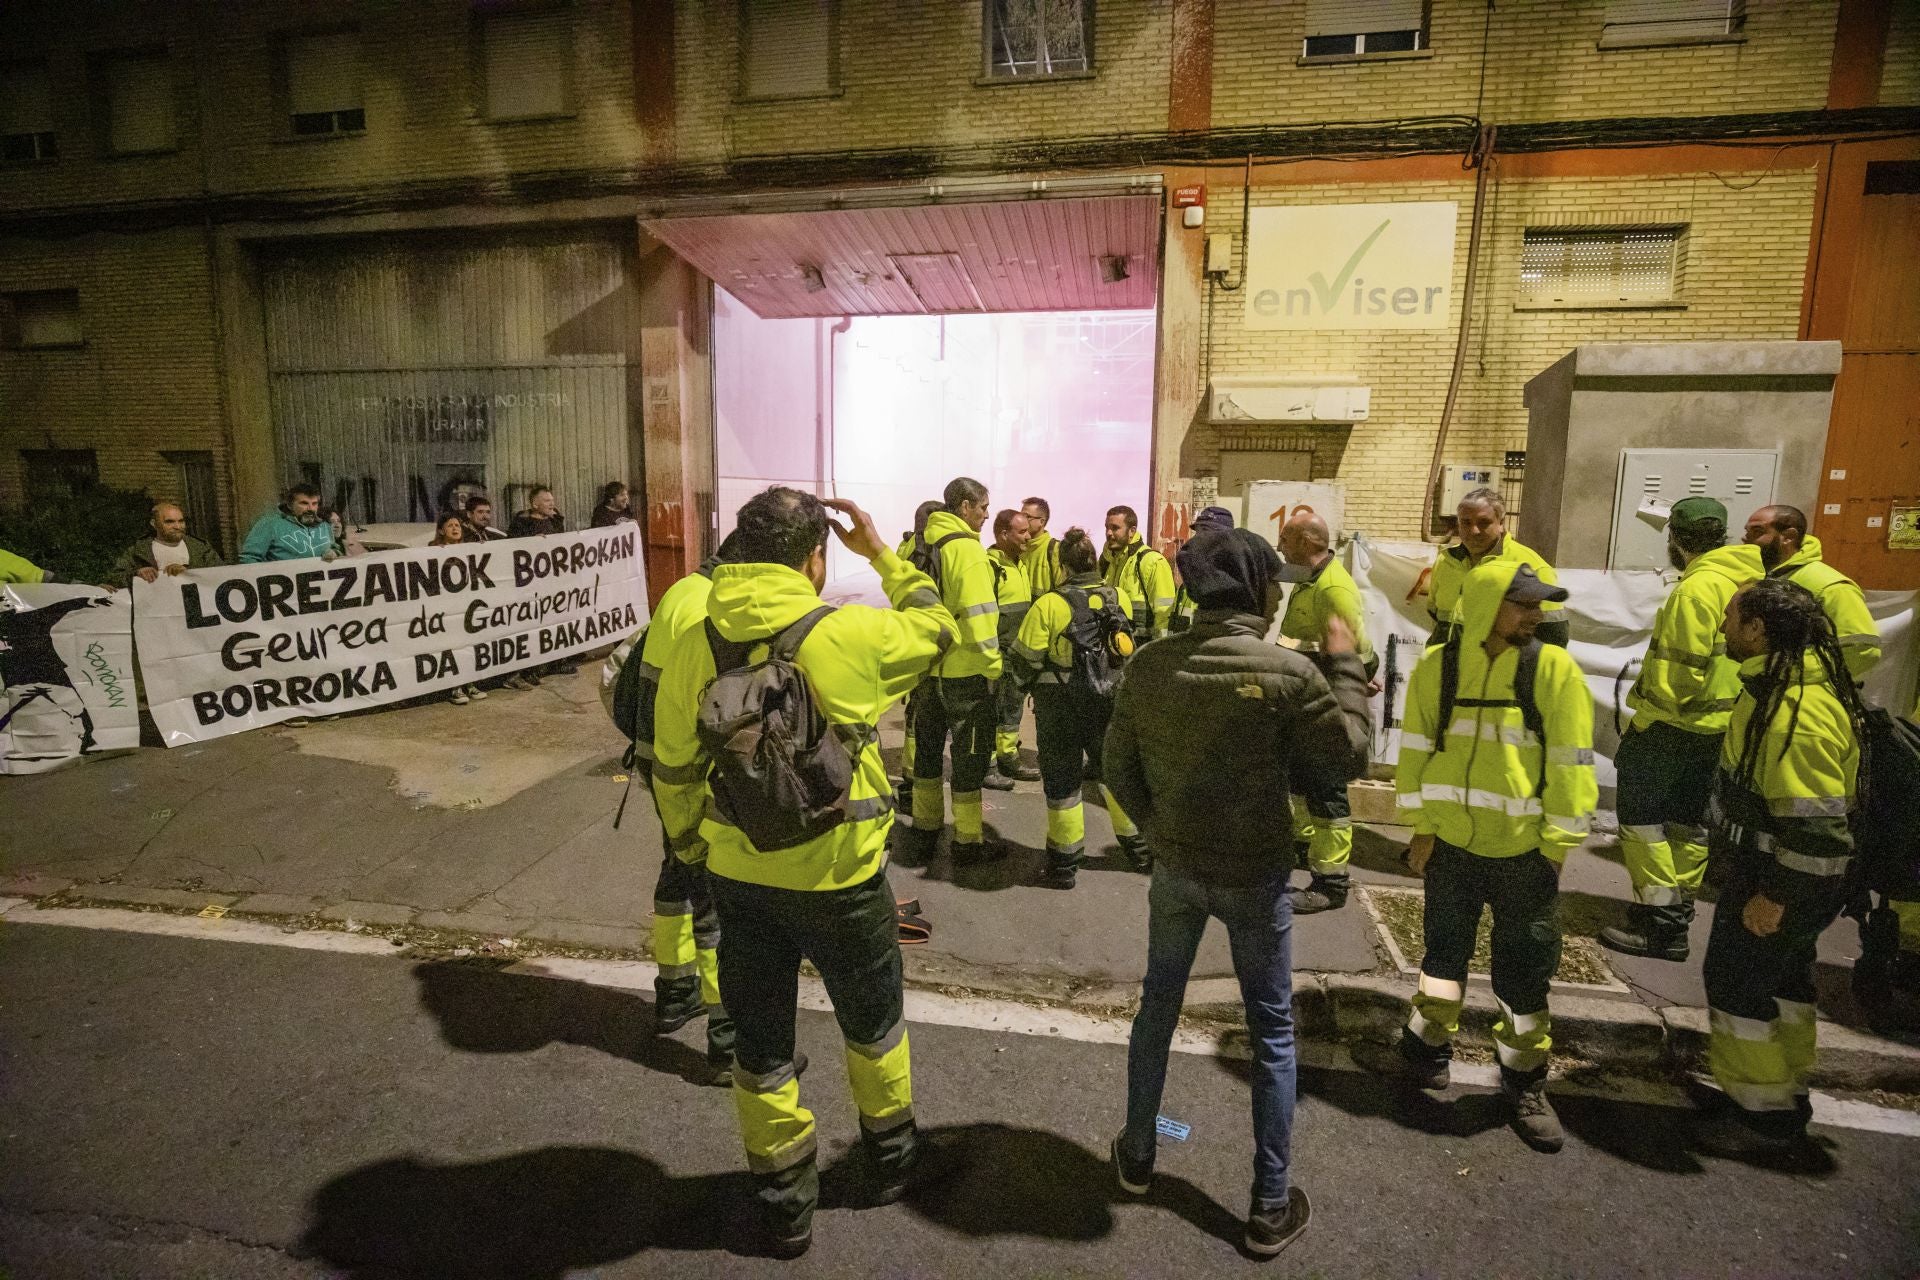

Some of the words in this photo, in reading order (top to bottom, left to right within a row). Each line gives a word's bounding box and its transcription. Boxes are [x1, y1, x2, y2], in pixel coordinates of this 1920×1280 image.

[180, 552, 497, 630] LOREZAINOK
[512, 531, 635, 588] BORROKAN
[220, 613, 389, 672] Geurea
[407, 603, 446, 639] da
[463, 573, 600, 634] Garaipena!
[192, 660, 398, 726] BORROKA
[415, 648, 460, 684] DA
[473, 633, 531, 672] BIDE
[538, 602, 638, 655] BAKARRA
